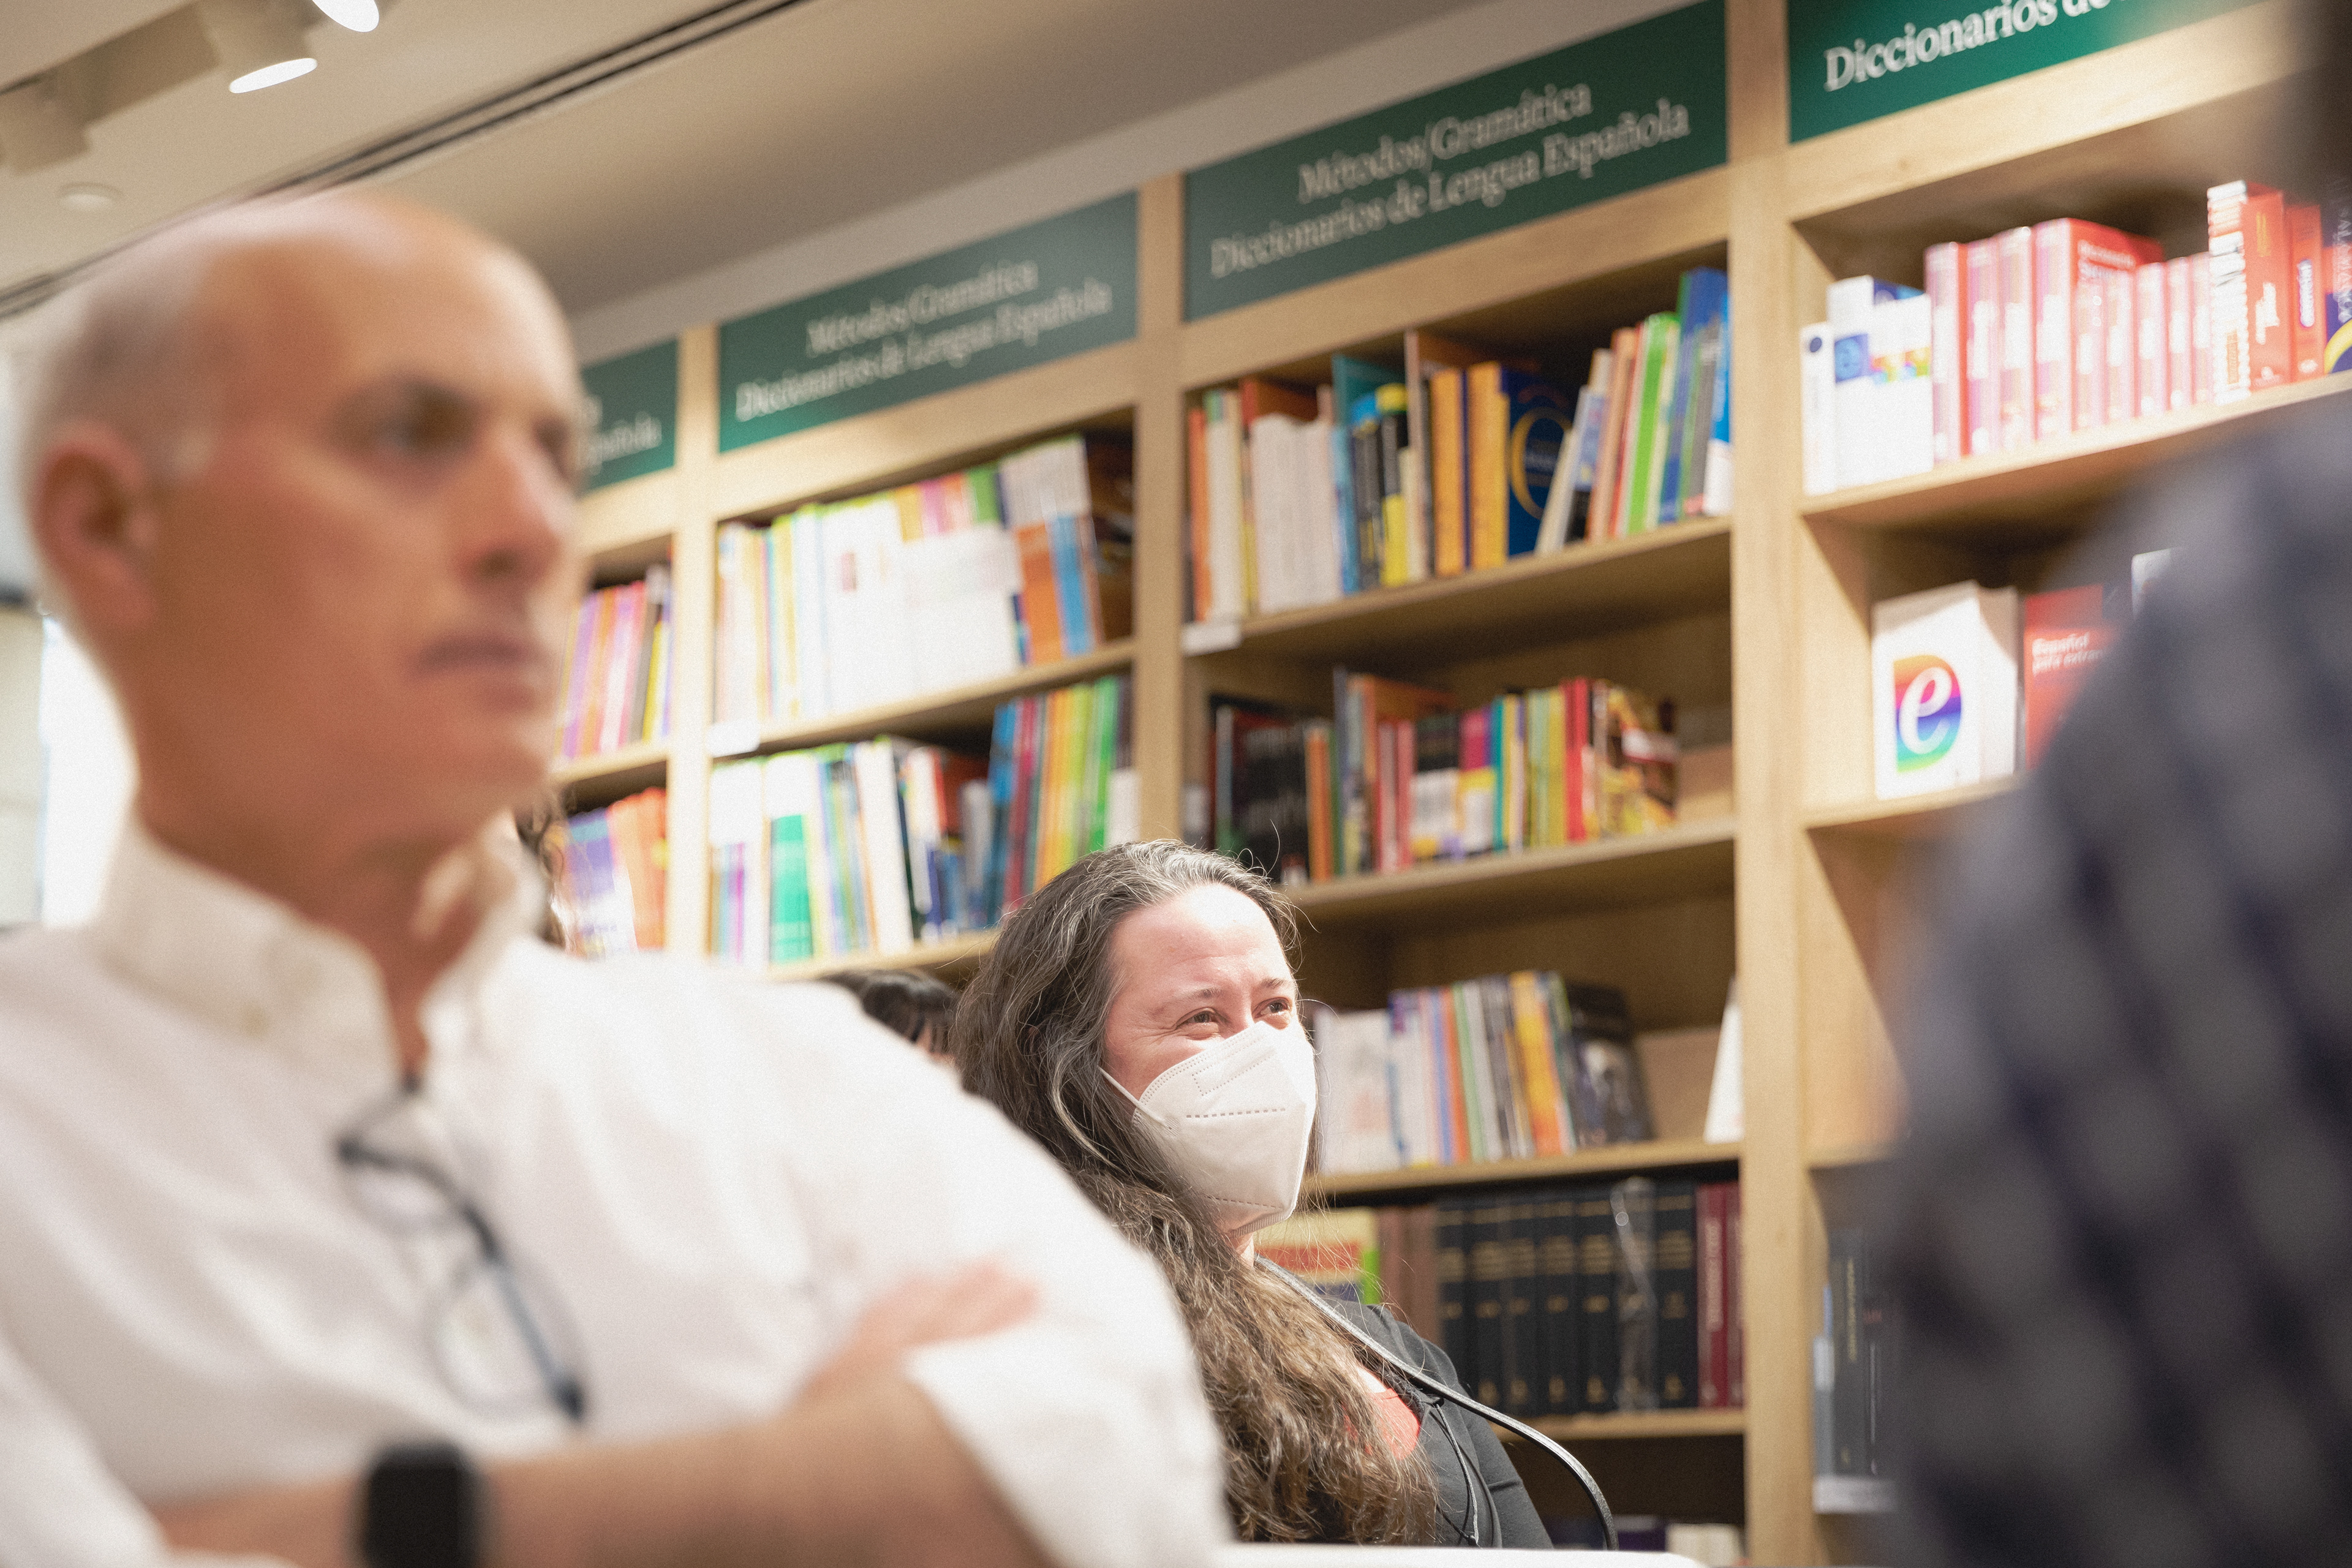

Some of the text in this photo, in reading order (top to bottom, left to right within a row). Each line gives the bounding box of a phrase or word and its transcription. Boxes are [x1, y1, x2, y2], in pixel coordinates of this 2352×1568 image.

[1823, 0, 2058, 92] Diccionarios
[1211, 97, 1691, 279] Diccionarios de Lengua Española
[735, 352, 880, 423] Diccionarios
[995, 276, 1112, 347] Española
